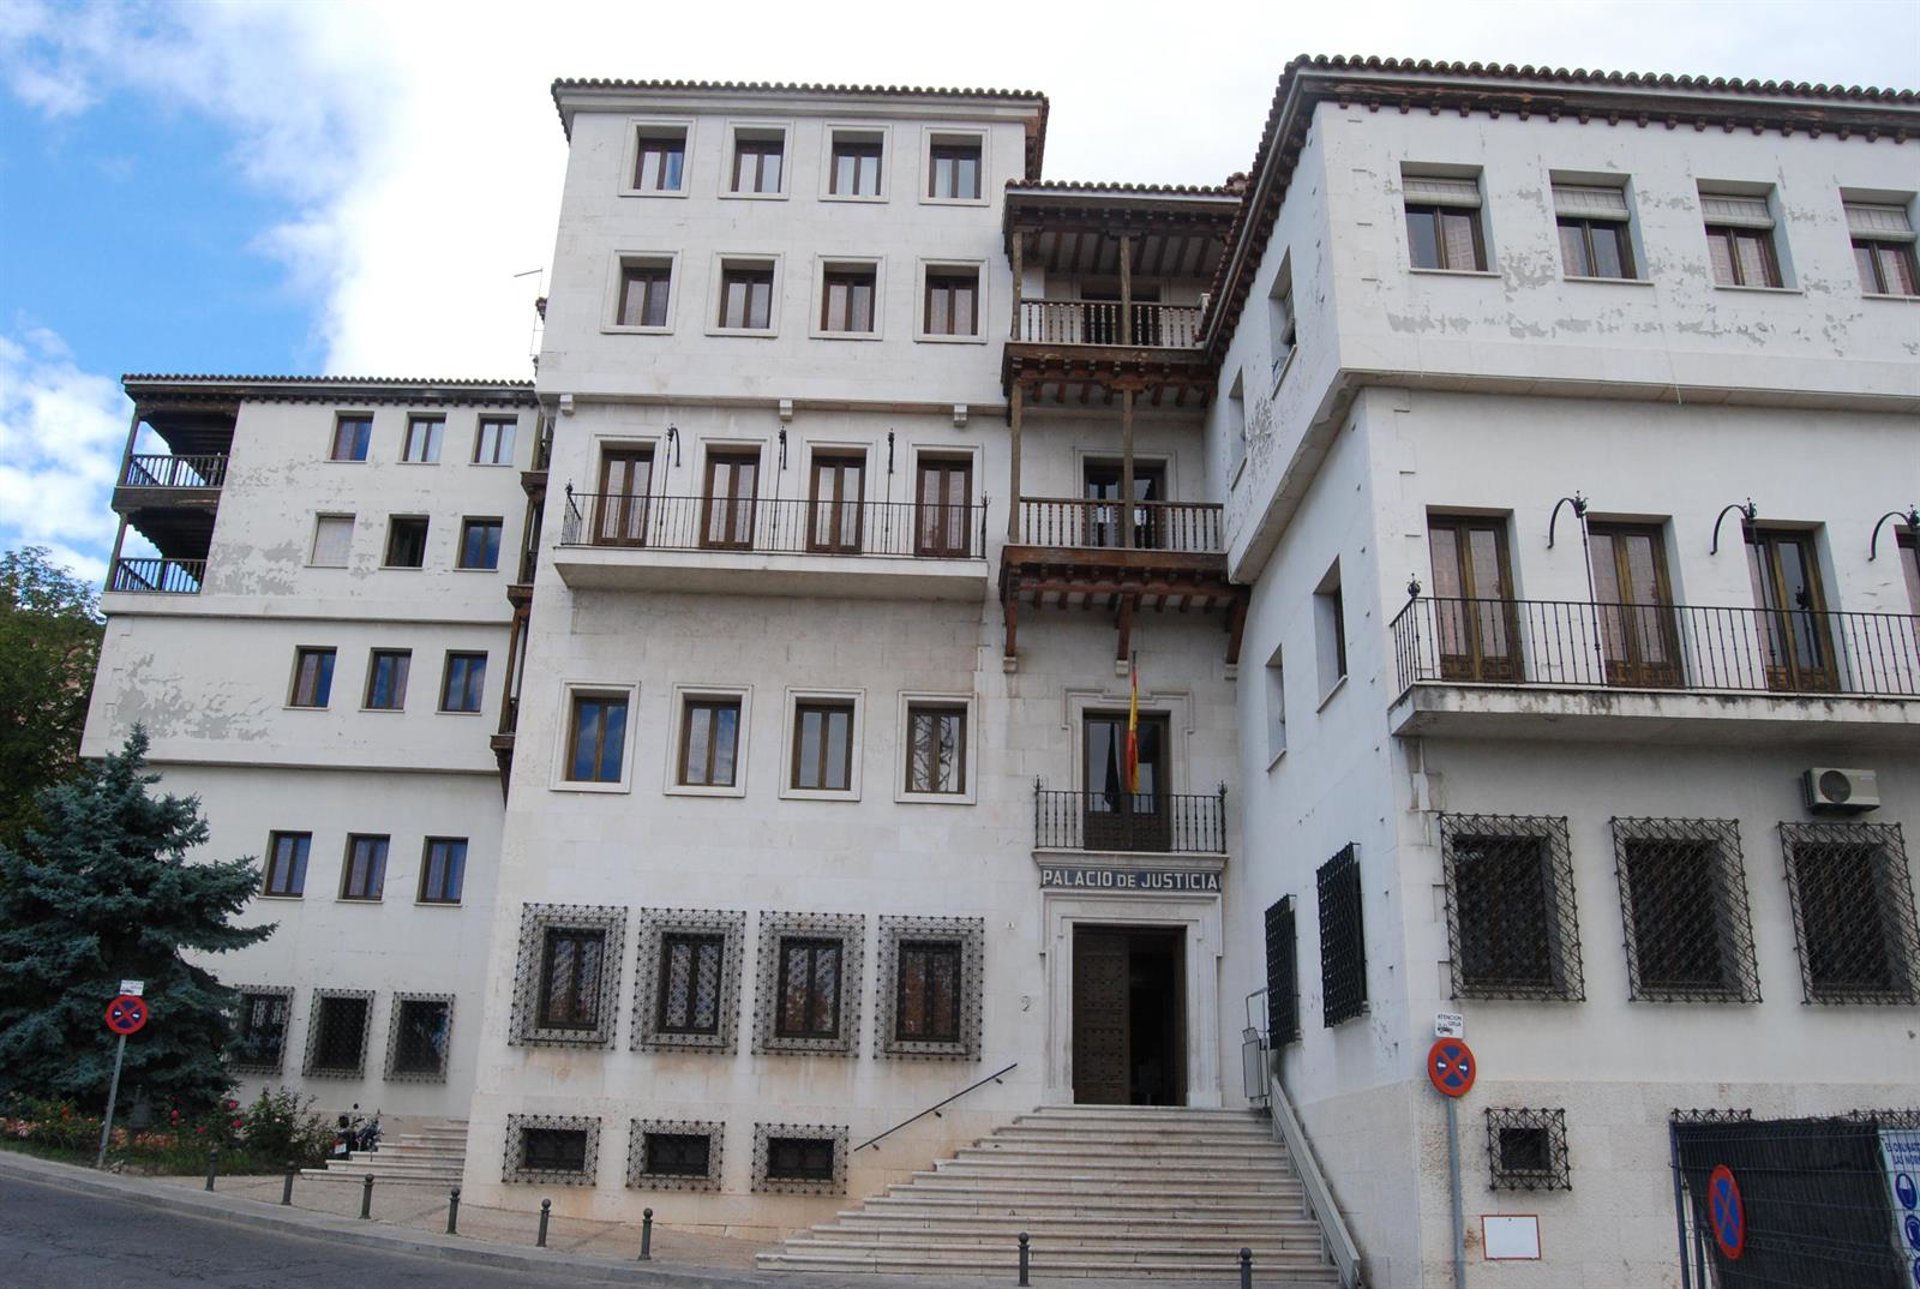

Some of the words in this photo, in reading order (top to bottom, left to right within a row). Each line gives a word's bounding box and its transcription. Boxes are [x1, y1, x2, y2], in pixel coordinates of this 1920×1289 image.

[1042, 869, 1112, 887] PALACIO
[1117, 874, 1136, 888] DE
[1141, 873, 1217, 889] JUSTICIA
